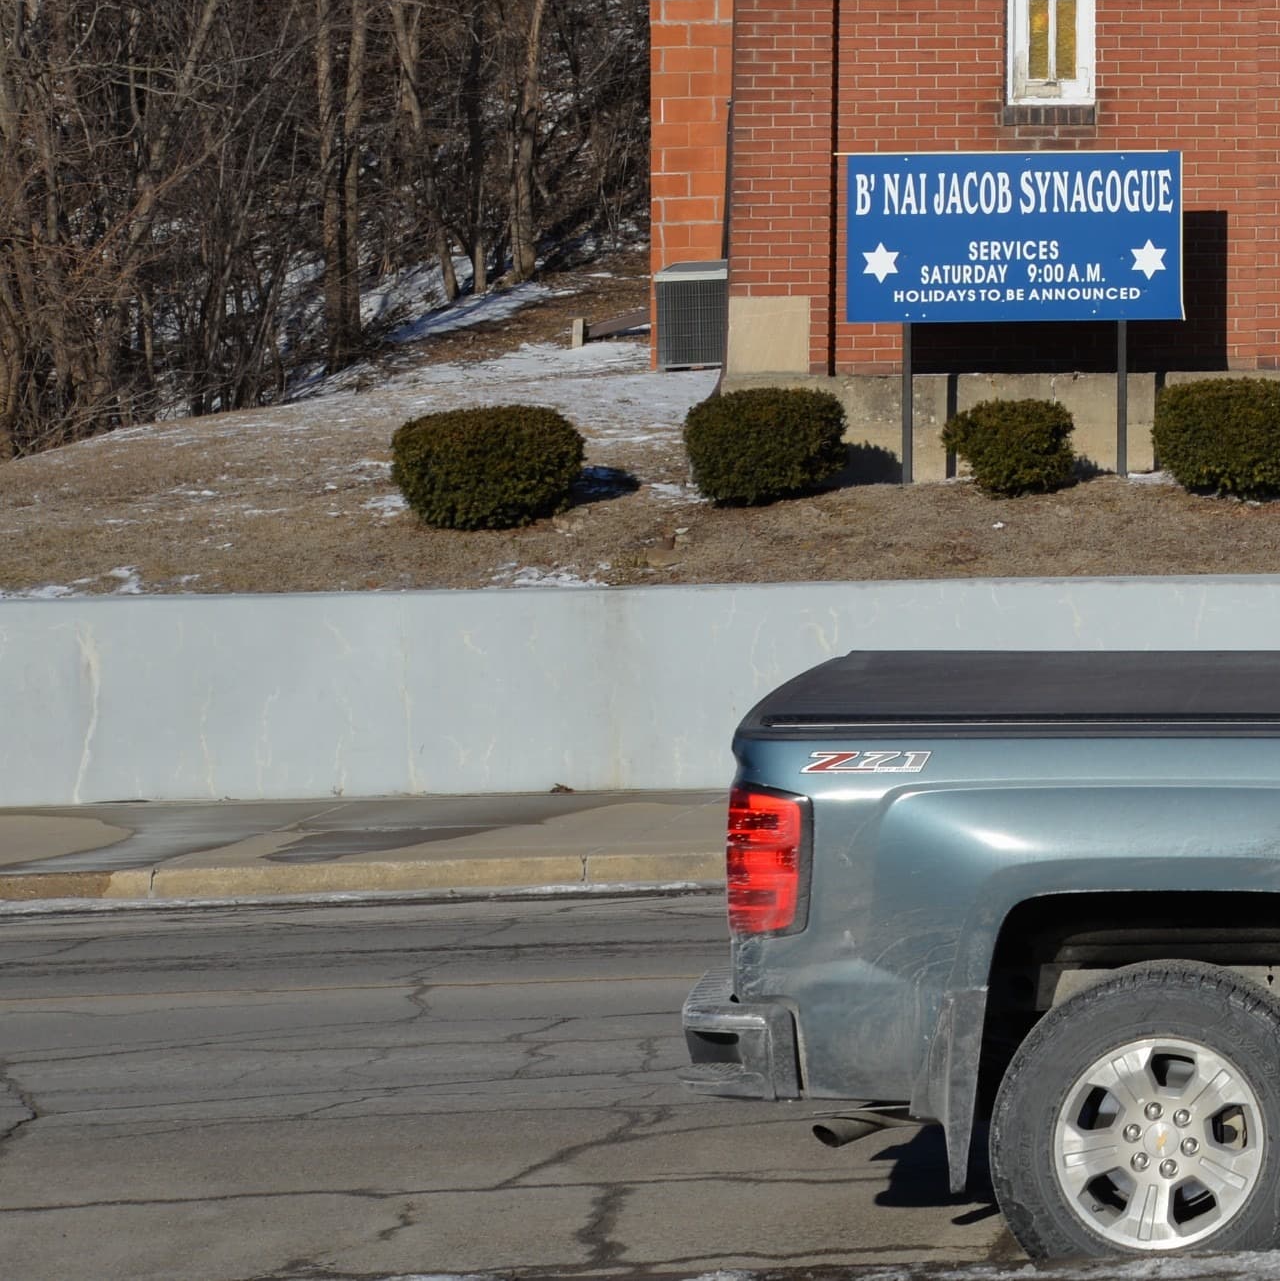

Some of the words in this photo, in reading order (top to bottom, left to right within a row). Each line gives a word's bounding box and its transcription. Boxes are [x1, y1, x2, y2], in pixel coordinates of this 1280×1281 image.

[934, 172, 1012, 214] JACOB
[1020, 169, 1173, 214] SYNAGOGUE
[969, 241, 1058, 260] SERVICES
[921, 265, 1007, 284] SATURDAY
[1028, 264, 1064, 282] 9:00
[1068, 264, 1105, 282] A.M.
[894, 290, 975, 302] HOLIDAYS
[980, 289, 1000, 301] TO
[1007, 289, 1024, 300] BE
[1029, 288, 1140, 300] ANNOUNCED
[800, 750, 932, 773] Z71
